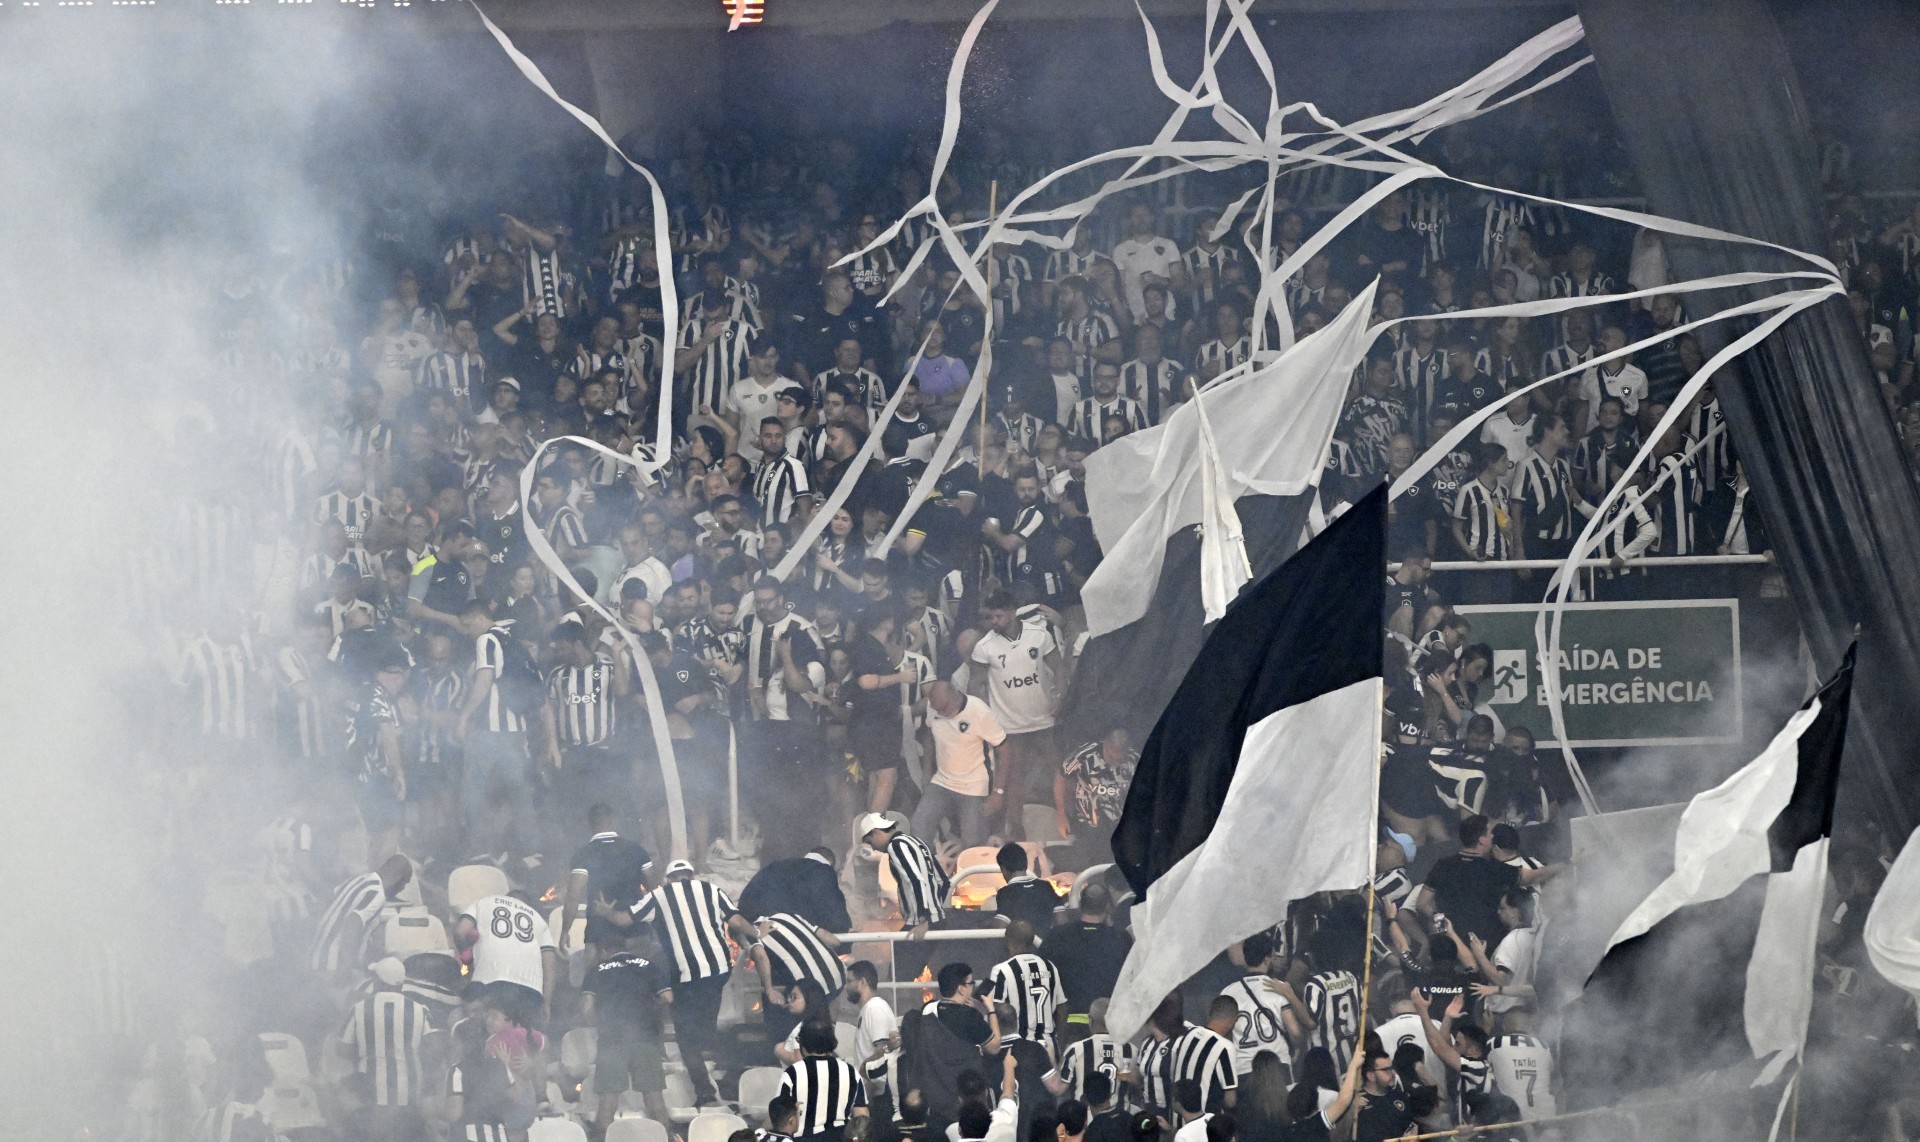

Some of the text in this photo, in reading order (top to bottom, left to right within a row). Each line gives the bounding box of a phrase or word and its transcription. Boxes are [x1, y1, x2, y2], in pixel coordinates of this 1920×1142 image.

[998, 654, 1007, 668] 7
[1628, 647, 1662, 670] DE
[1003, 673, 1039, 689] vbet
[1536, 676, 1714, 706] EMERGÊNCIA
[565, 693, 597, 706] vbet
[491, 906, 534, 943] 89
[1423, 986, 1464, 994] LQUIGAS
[1029, 985, 1050, 1024] 7
[1237, 1007, 1277, 1049] 20
